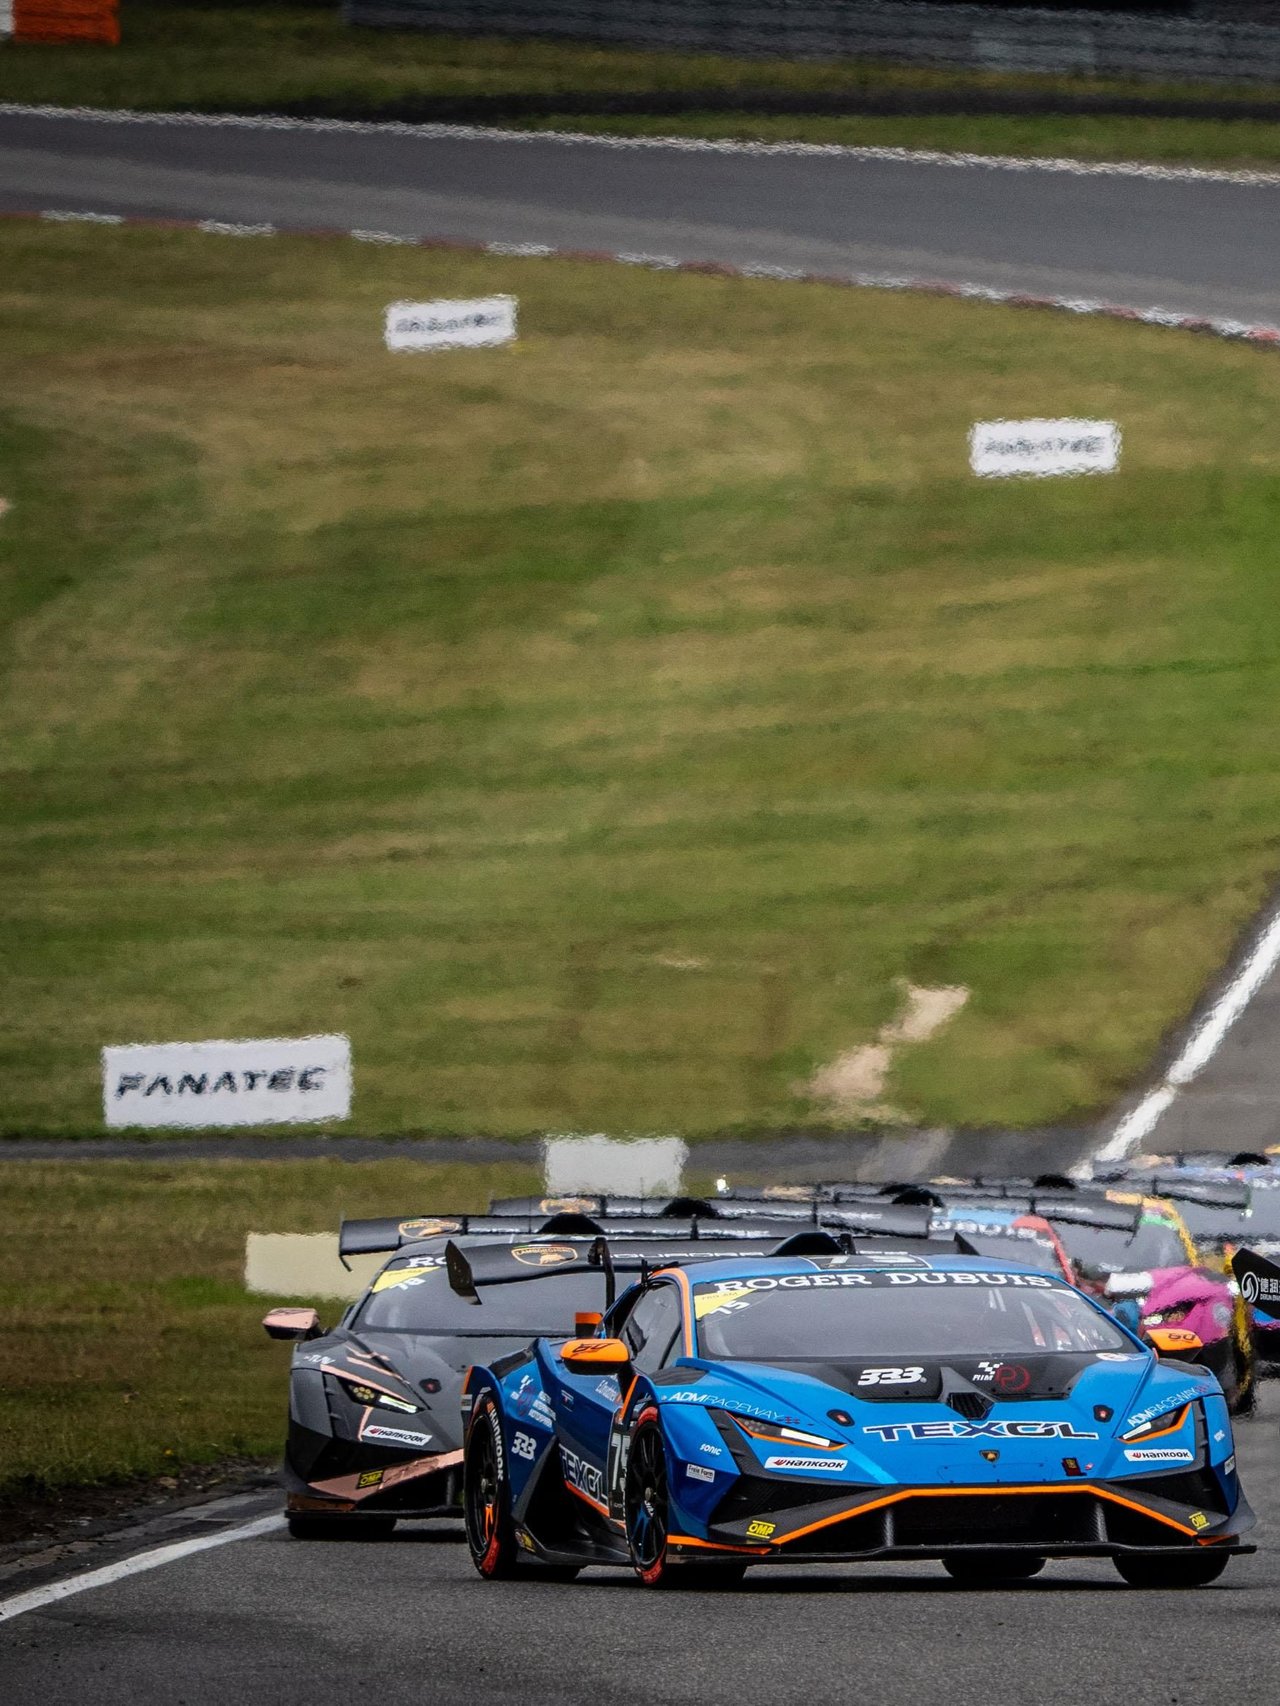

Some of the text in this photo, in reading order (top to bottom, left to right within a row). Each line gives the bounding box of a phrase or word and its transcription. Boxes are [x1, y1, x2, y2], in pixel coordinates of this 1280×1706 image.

[115, 1065, 329, 1099] FANATEC
[716, 1272, 1052, 1293] ROGER DUBUIS
[709, 1300, 751, 1315] 75
[857, 1367, 924, 1387] 333
[748, 1523, 775, 1536] OMP
